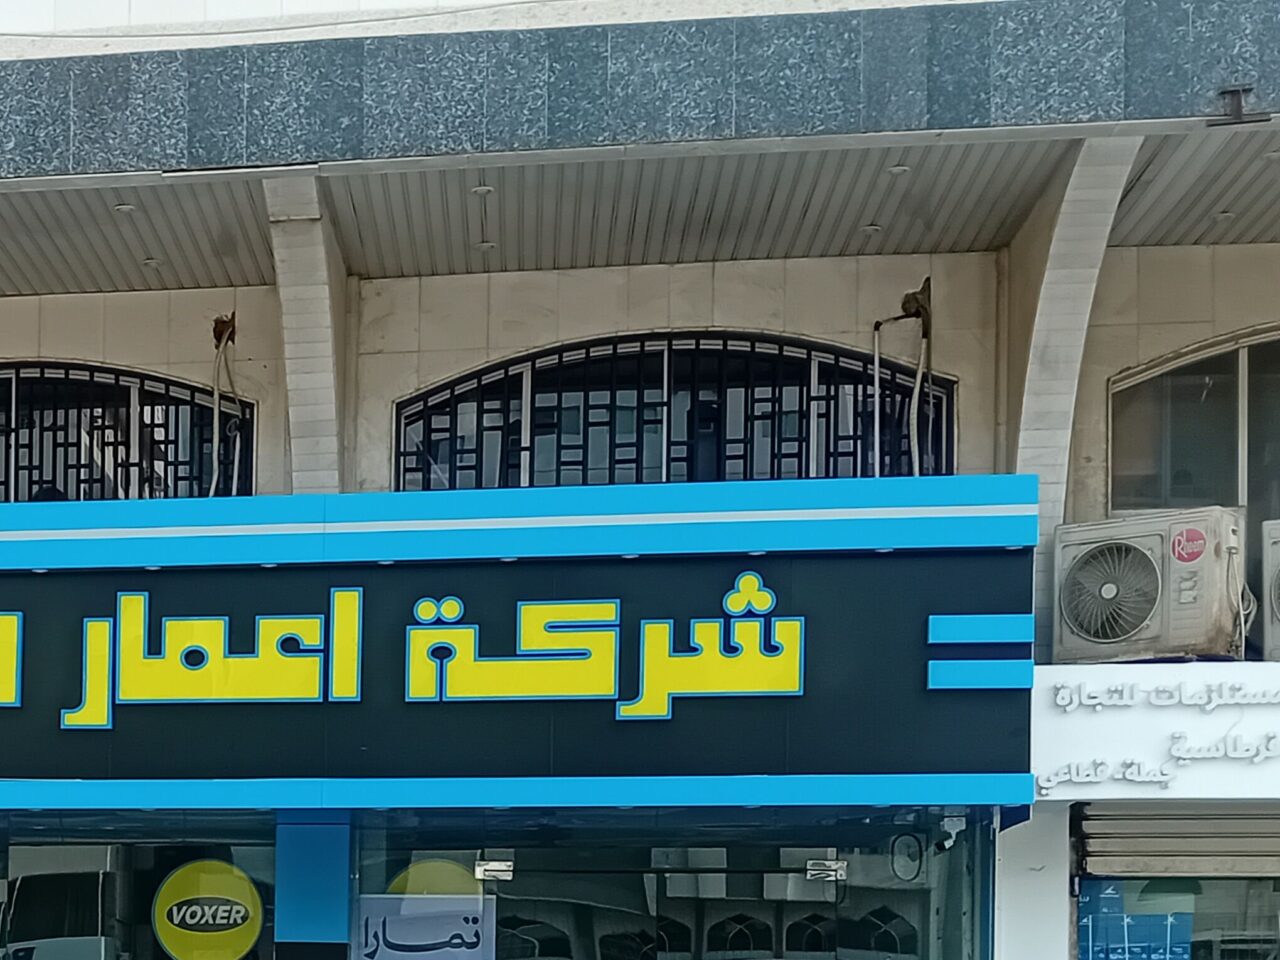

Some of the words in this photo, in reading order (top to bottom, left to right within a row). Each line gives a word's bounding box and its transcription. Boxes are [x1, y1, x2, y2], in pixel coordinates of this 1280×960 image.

[61, 587, 363, 729] اعمار
[405, 571, 805, 721] شركة
[171, 904, 248, 925] VOXER
[363, 916, 481, 960] تمارا
